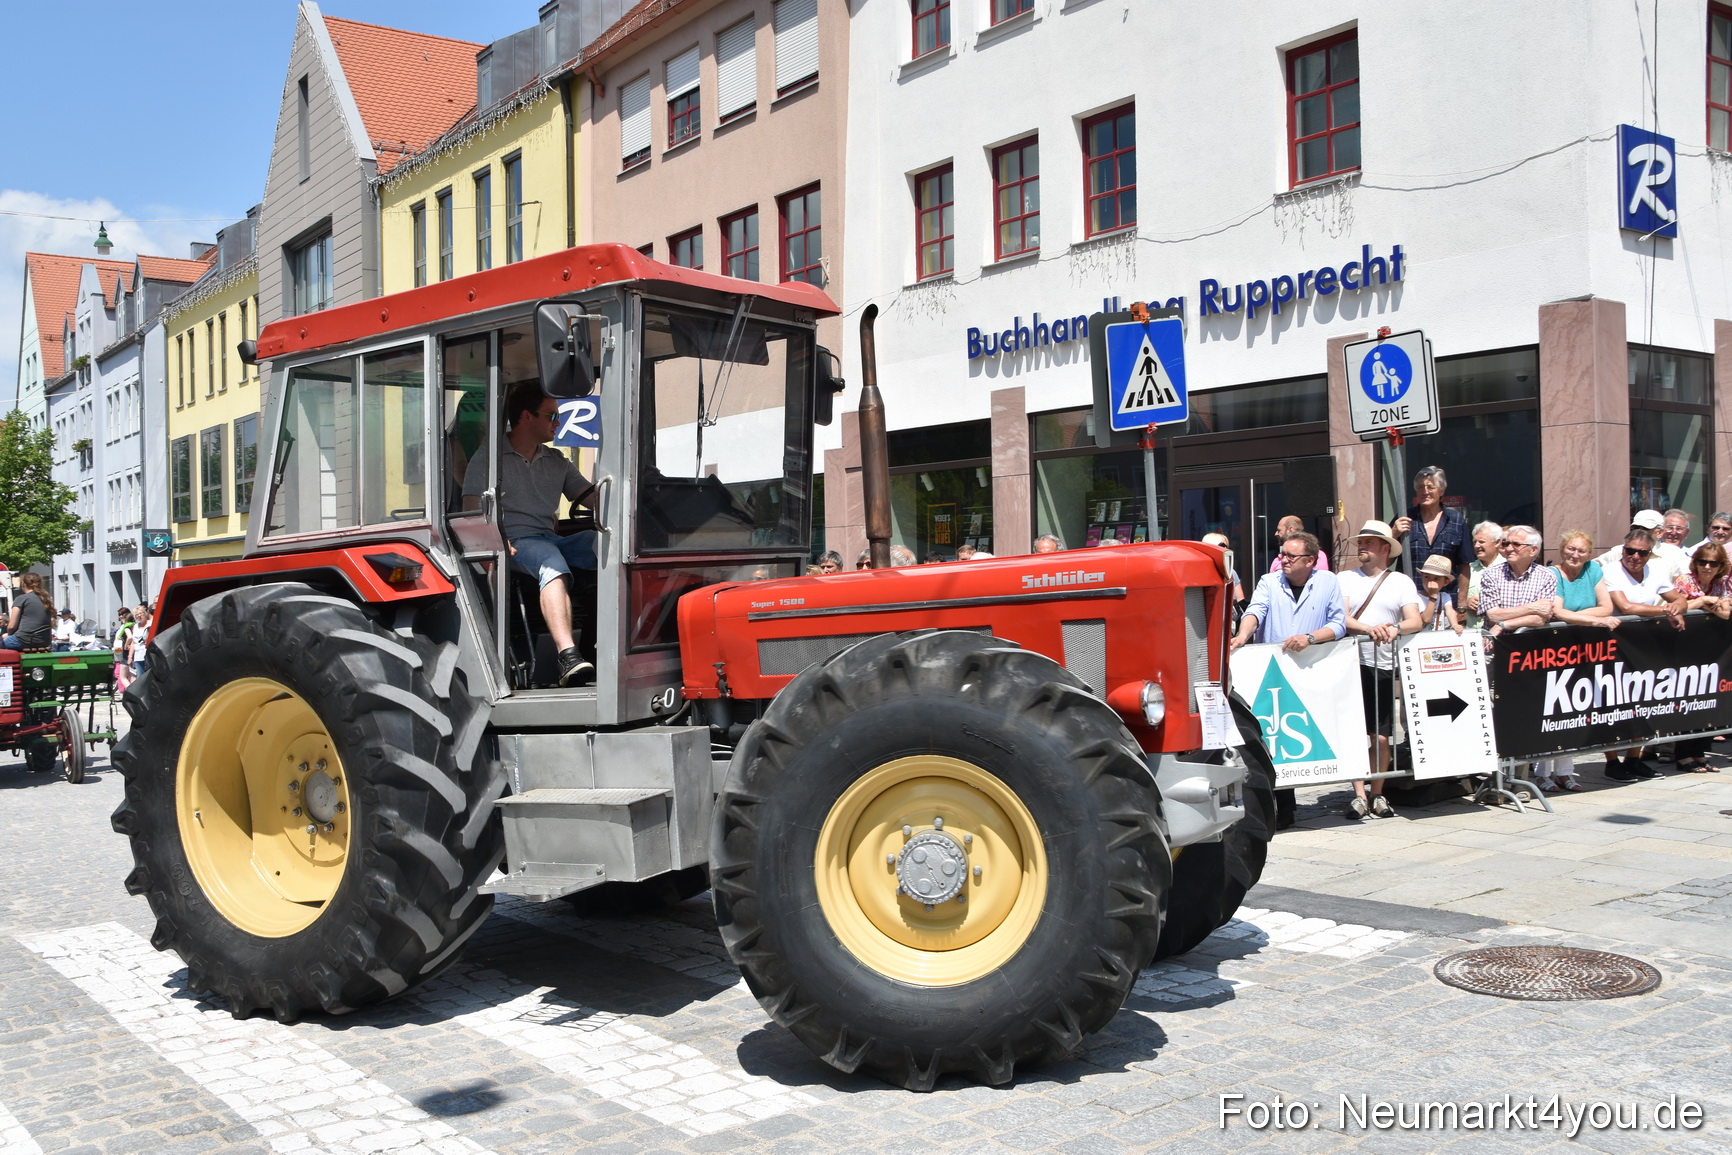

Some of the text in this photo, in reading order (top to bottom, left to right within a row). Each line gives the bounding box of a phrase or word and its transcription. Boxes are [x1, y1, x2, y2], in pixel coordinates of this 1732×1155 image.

[967, 243, 1406, 360] Buchhan Rupprecht
[1370, 405, 1410, 425] ZONE
[1508, 639, 1617, 674] FAHRSCHULE
[1403, 647, 1426, 764] RESIDENZPLATZ
[1470, 642, 1491, 756] RESIDENZPLATZ
[1543, 661, 1719, 717] Kohlmann
[1541, 698, 1717, 733] Neumarkt Burgthann Freystadt Pyrbaum
[1281, 767, 1310, 779] Service
[1313, 764, 1338, 776] GmbH
